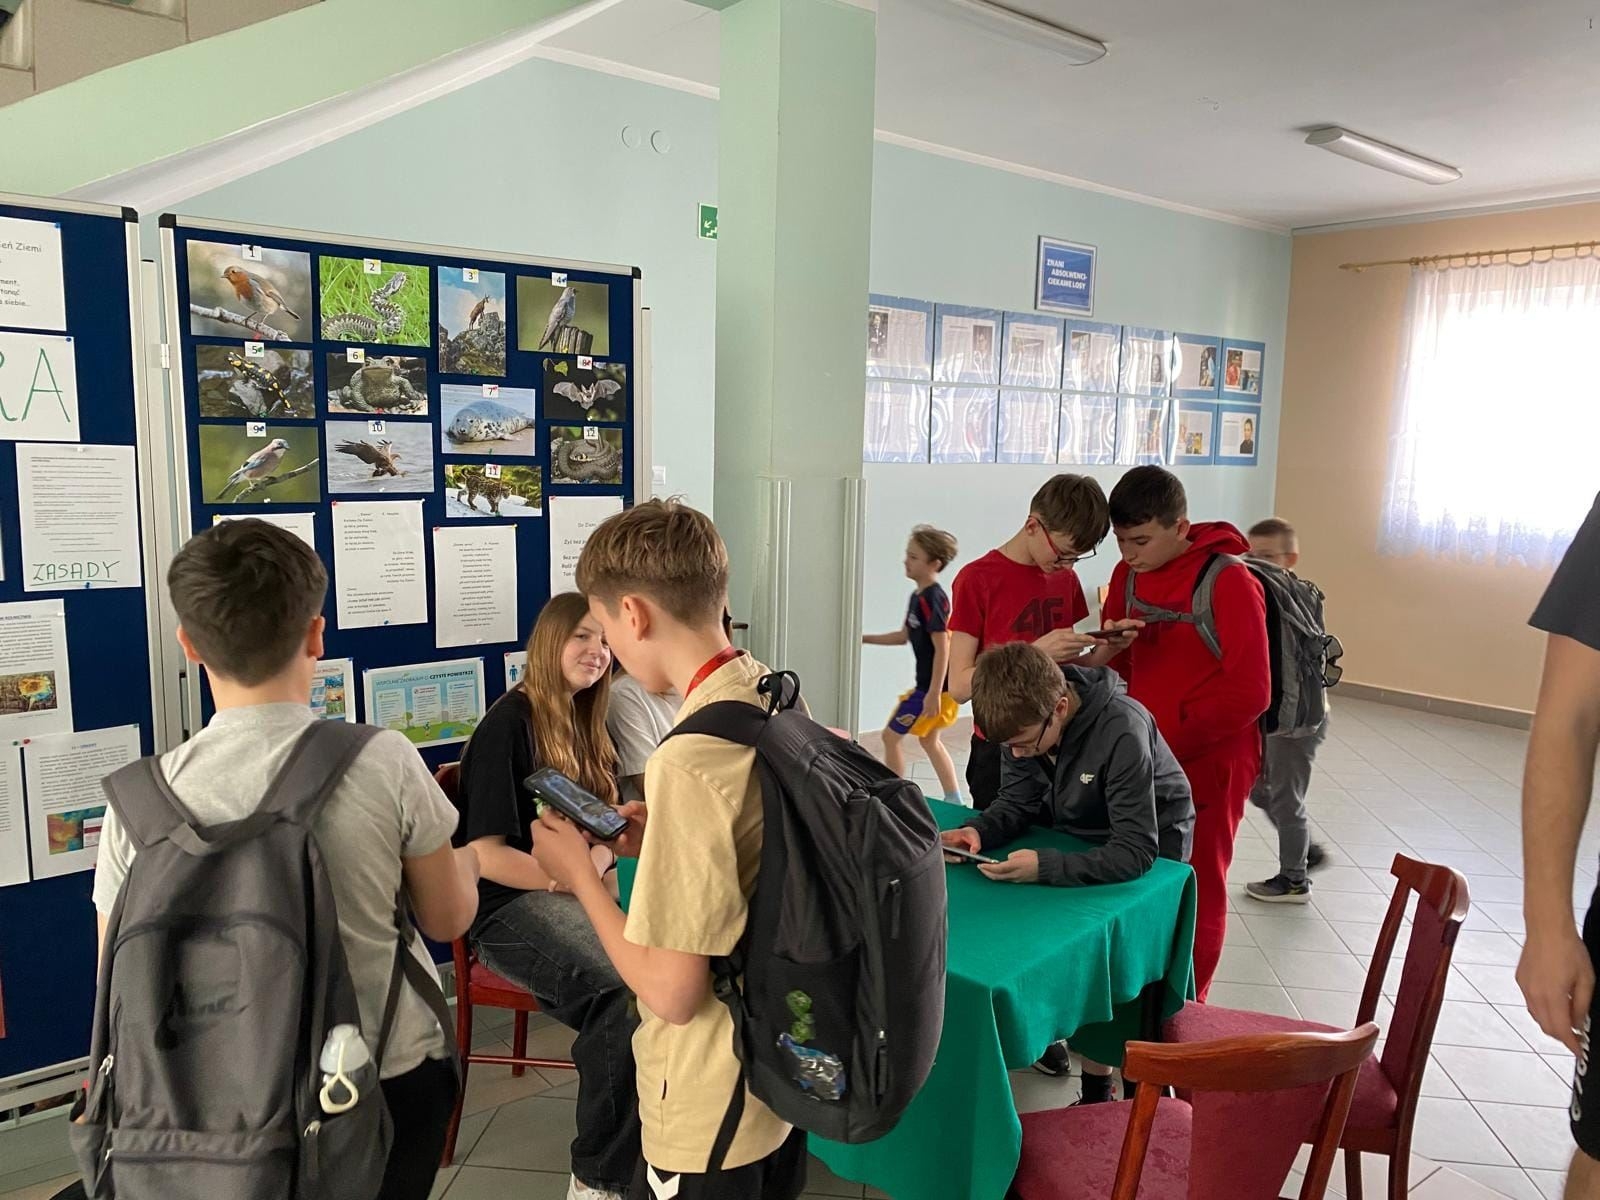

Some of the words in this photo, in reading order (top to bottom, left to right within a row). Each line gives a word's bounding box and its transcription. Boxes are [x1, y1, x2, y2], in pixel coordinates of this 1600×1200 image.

[15, 242, 42, 253] Ziemi
[369, 263, 375, 271] 2
[1047, 259, 1064, 268] ZNANI
[372, 423, 383, 432] 10
[586, 429, 596, 437] 12
[488, 467, 498, 476] 11
[33, 561, 120, 581] ZASADY
